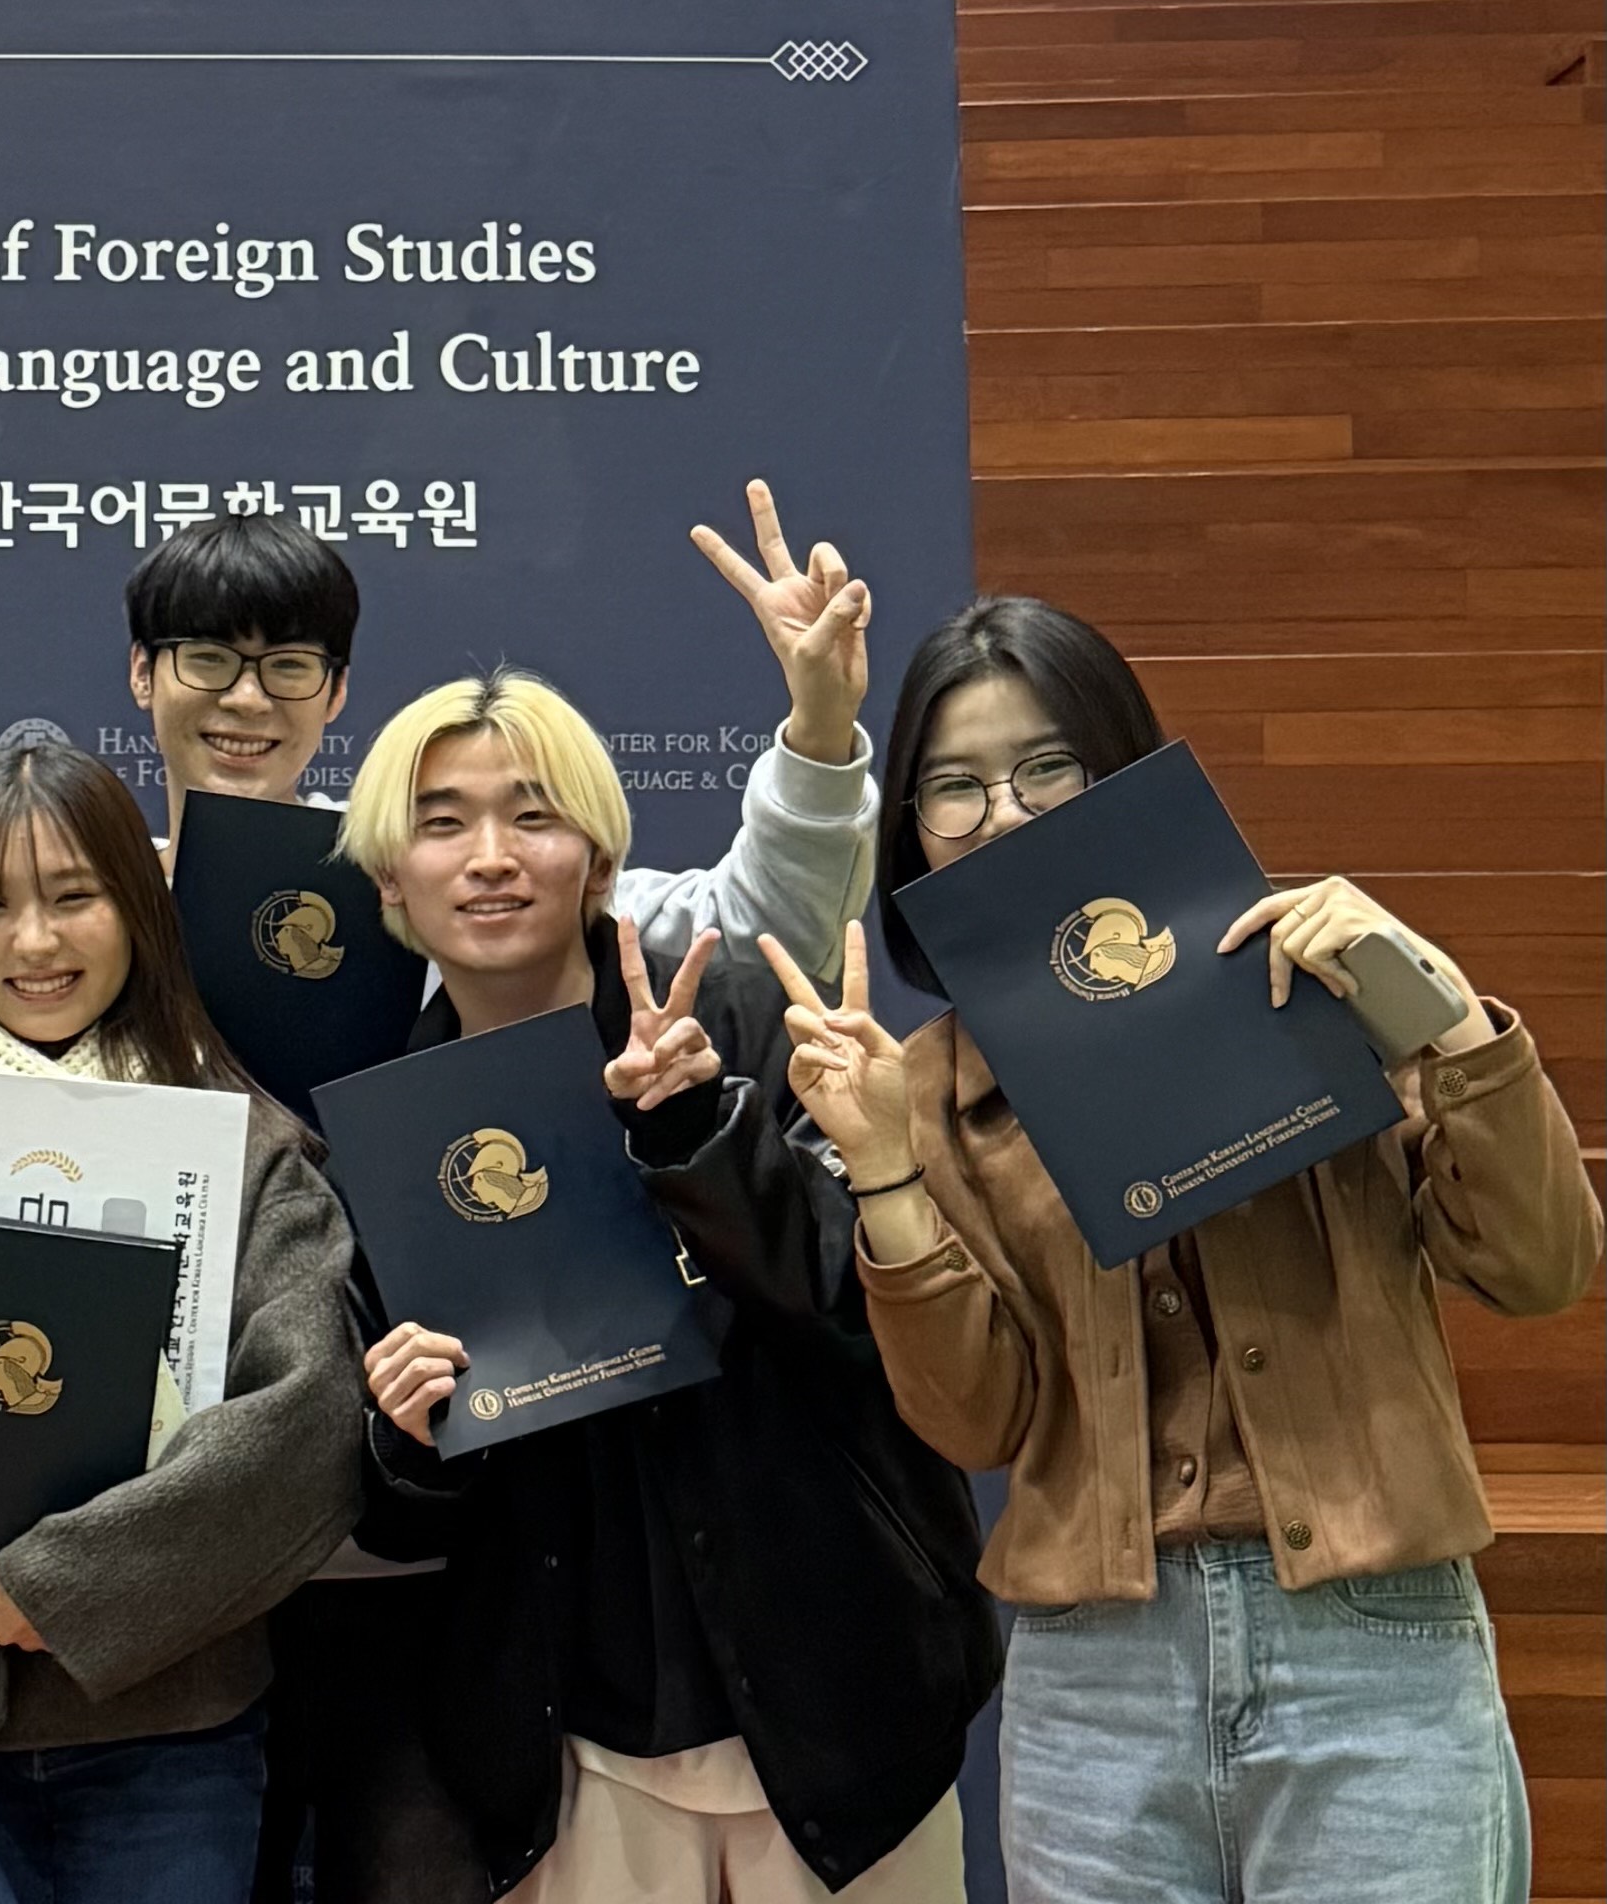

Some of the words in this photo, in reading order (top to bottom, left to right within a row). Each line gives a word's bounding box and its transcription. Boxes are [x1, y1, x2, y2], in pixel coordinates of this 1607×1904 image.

[53, 222, 320, 298] Foreign
[343, 221, 597, 283] Studies
[285, 329, 415, 392] and
[439, 330, 701, 393] Culture
[97, 726, 158, 755] HAN
[665, 733, 711, 753] FOR
[719, 726, 772, 753] KOR
[619, 770, 694, 790] GUAGE
[700, 770, 719, 790] &
